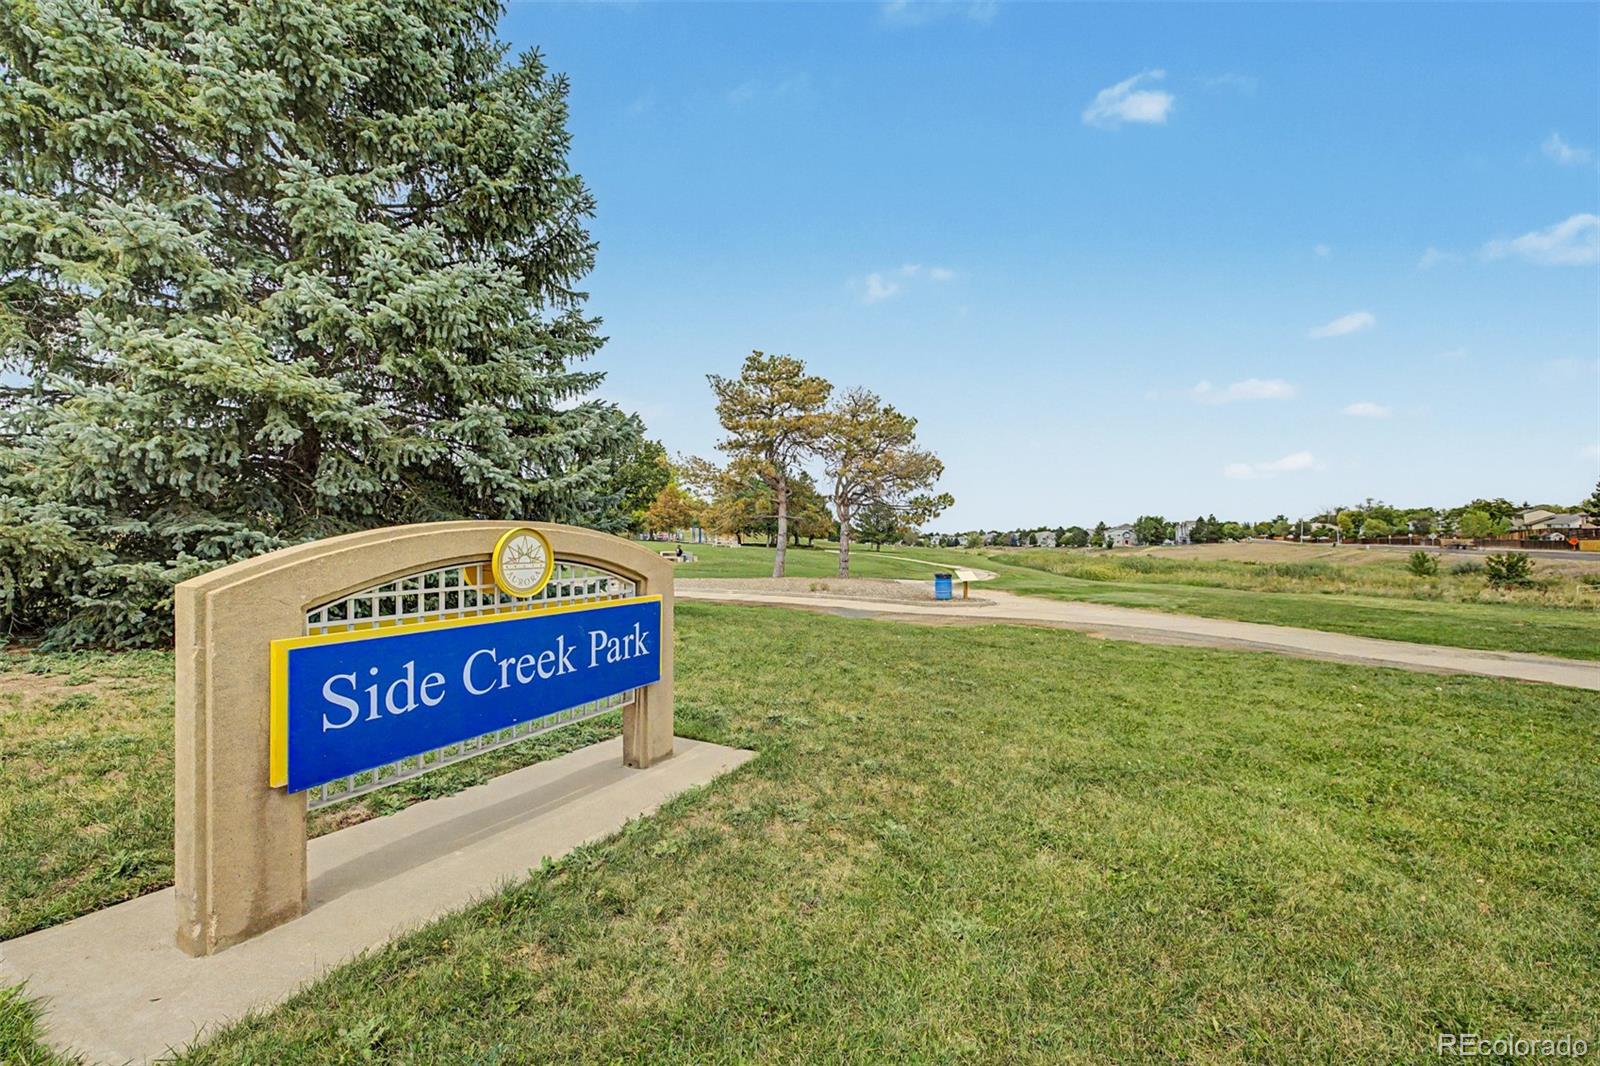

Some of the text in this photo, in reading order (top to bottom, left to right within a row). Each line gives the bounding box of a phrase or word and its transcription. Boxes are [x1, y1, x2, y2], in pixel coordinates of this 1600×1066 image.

[322, 622, 650, 733] Side Creek Park
